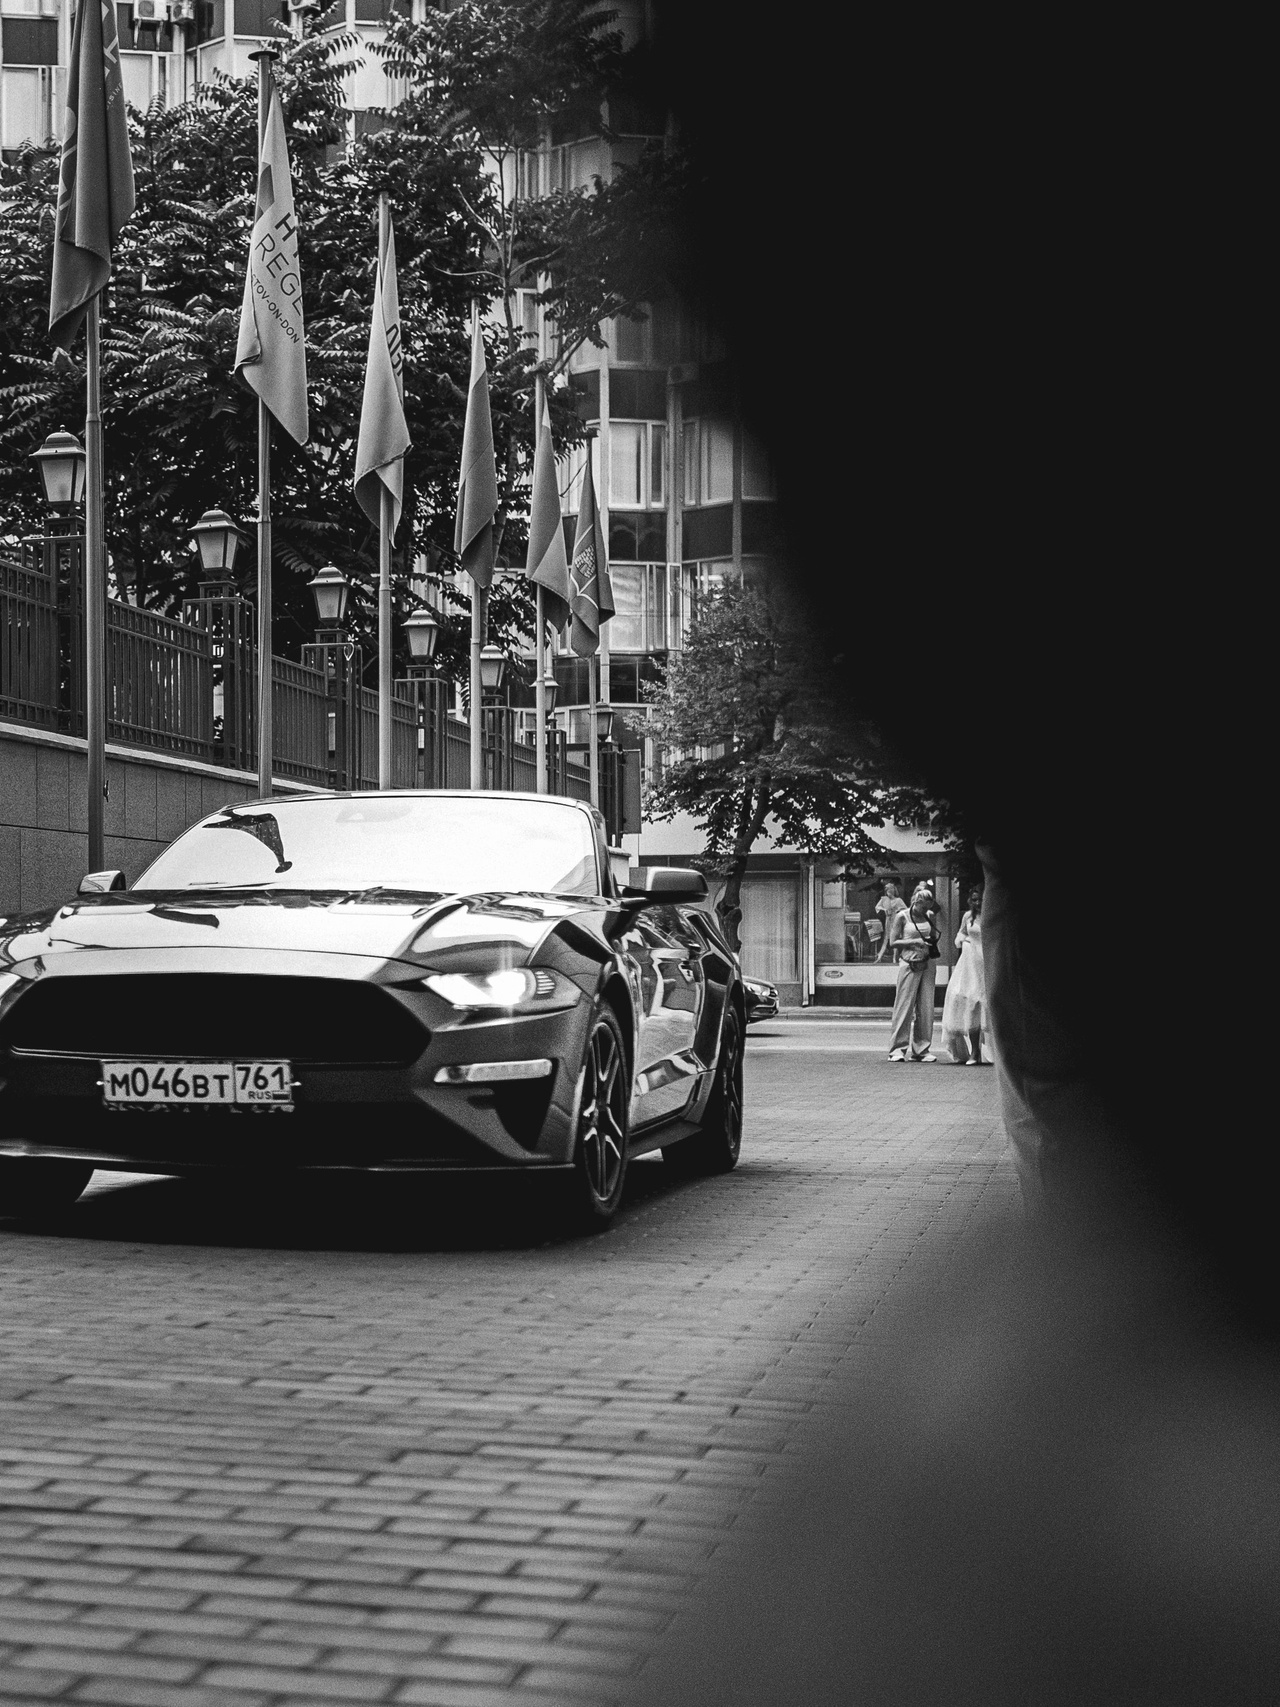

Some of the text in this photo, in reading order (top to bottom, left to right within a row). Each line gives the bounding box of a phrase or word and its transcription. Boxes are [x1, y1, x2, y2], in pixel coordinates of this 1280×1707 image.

[110, 1066, 285, 1099] M046BT 761
[248, 1090, 271, 1100] RUS
